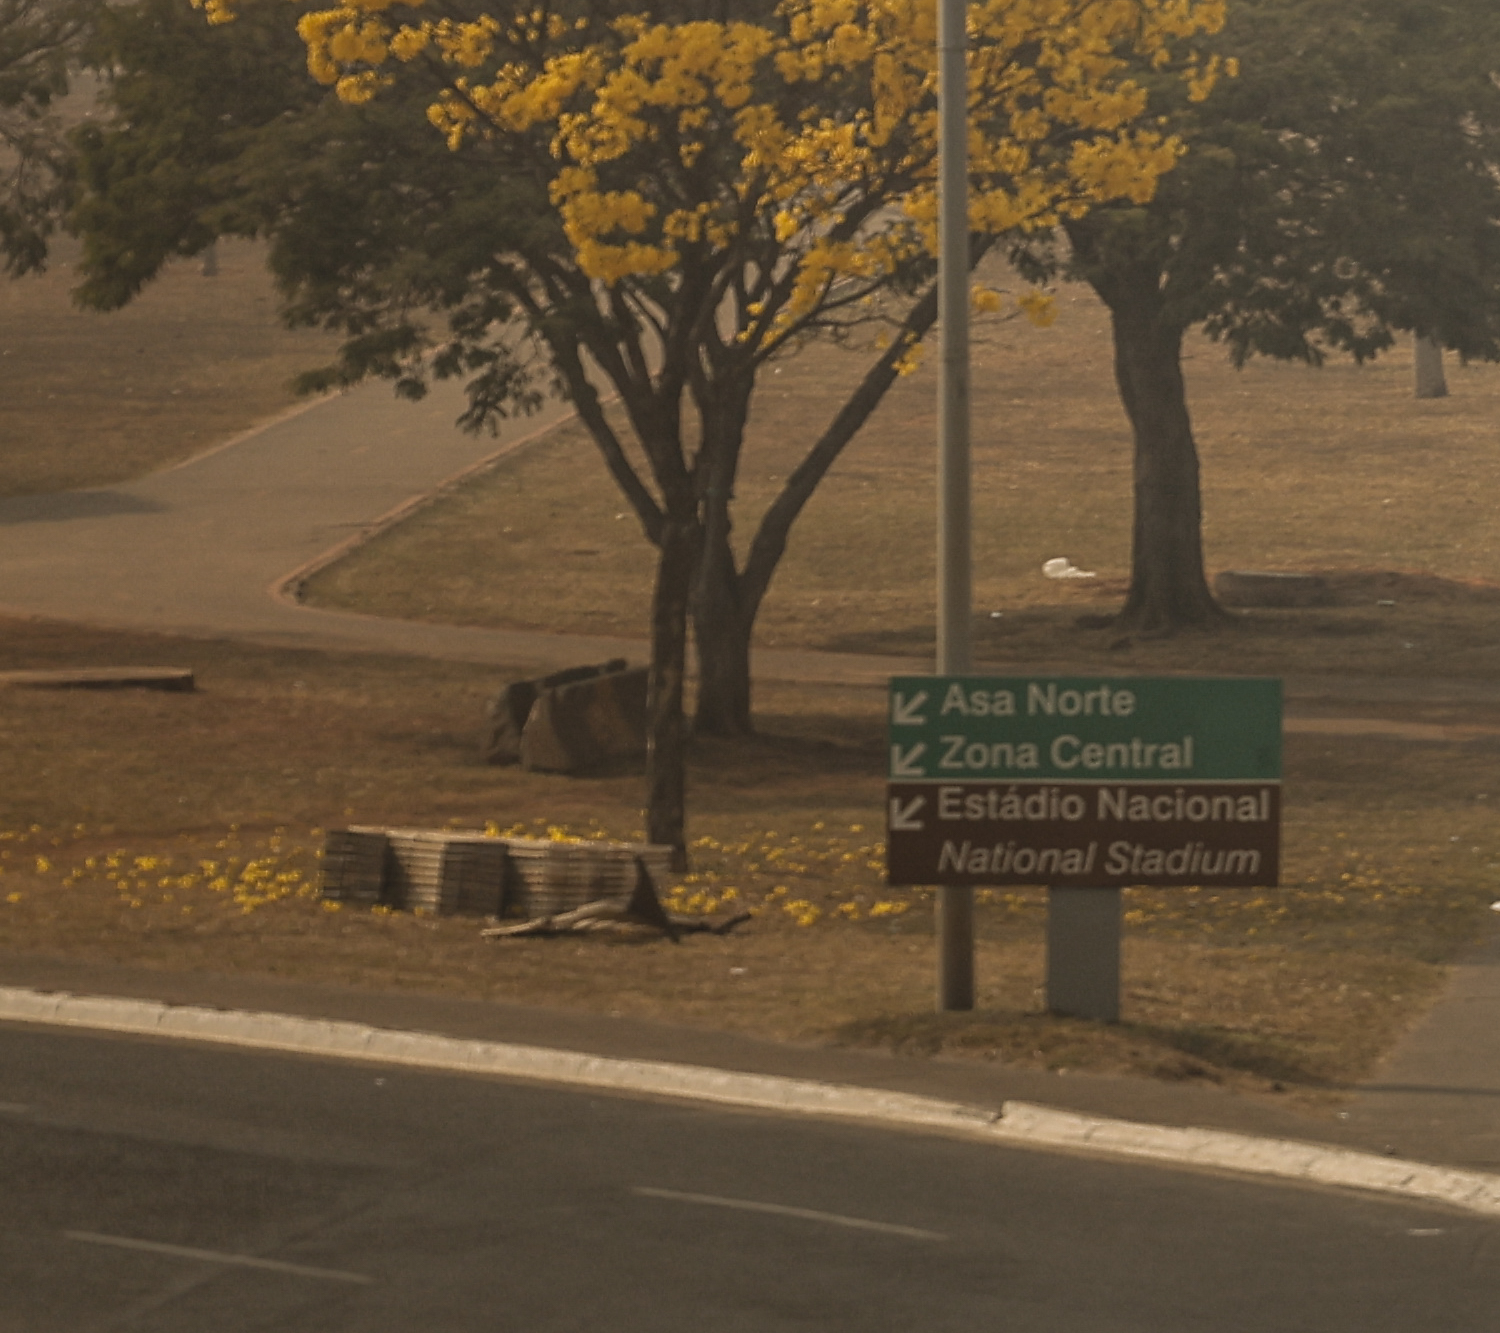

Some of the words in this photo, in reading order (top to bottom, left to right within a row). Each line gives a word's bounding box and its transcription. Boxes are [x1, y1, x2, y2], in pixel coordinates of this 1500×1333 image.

[940, 683, 1015, 716] Asa
[1026, 683, 1136, 716] Norte
[938, 736, 1039, 769] Zona
[1050, 734, 1194, 769] Central
[937, 786, 1085, 821] Estádio
[1097, 788, 1270, 823] Nacional
[937, 840, 1097, 875] National
[1105, 841, 1262, 876] Stadium
